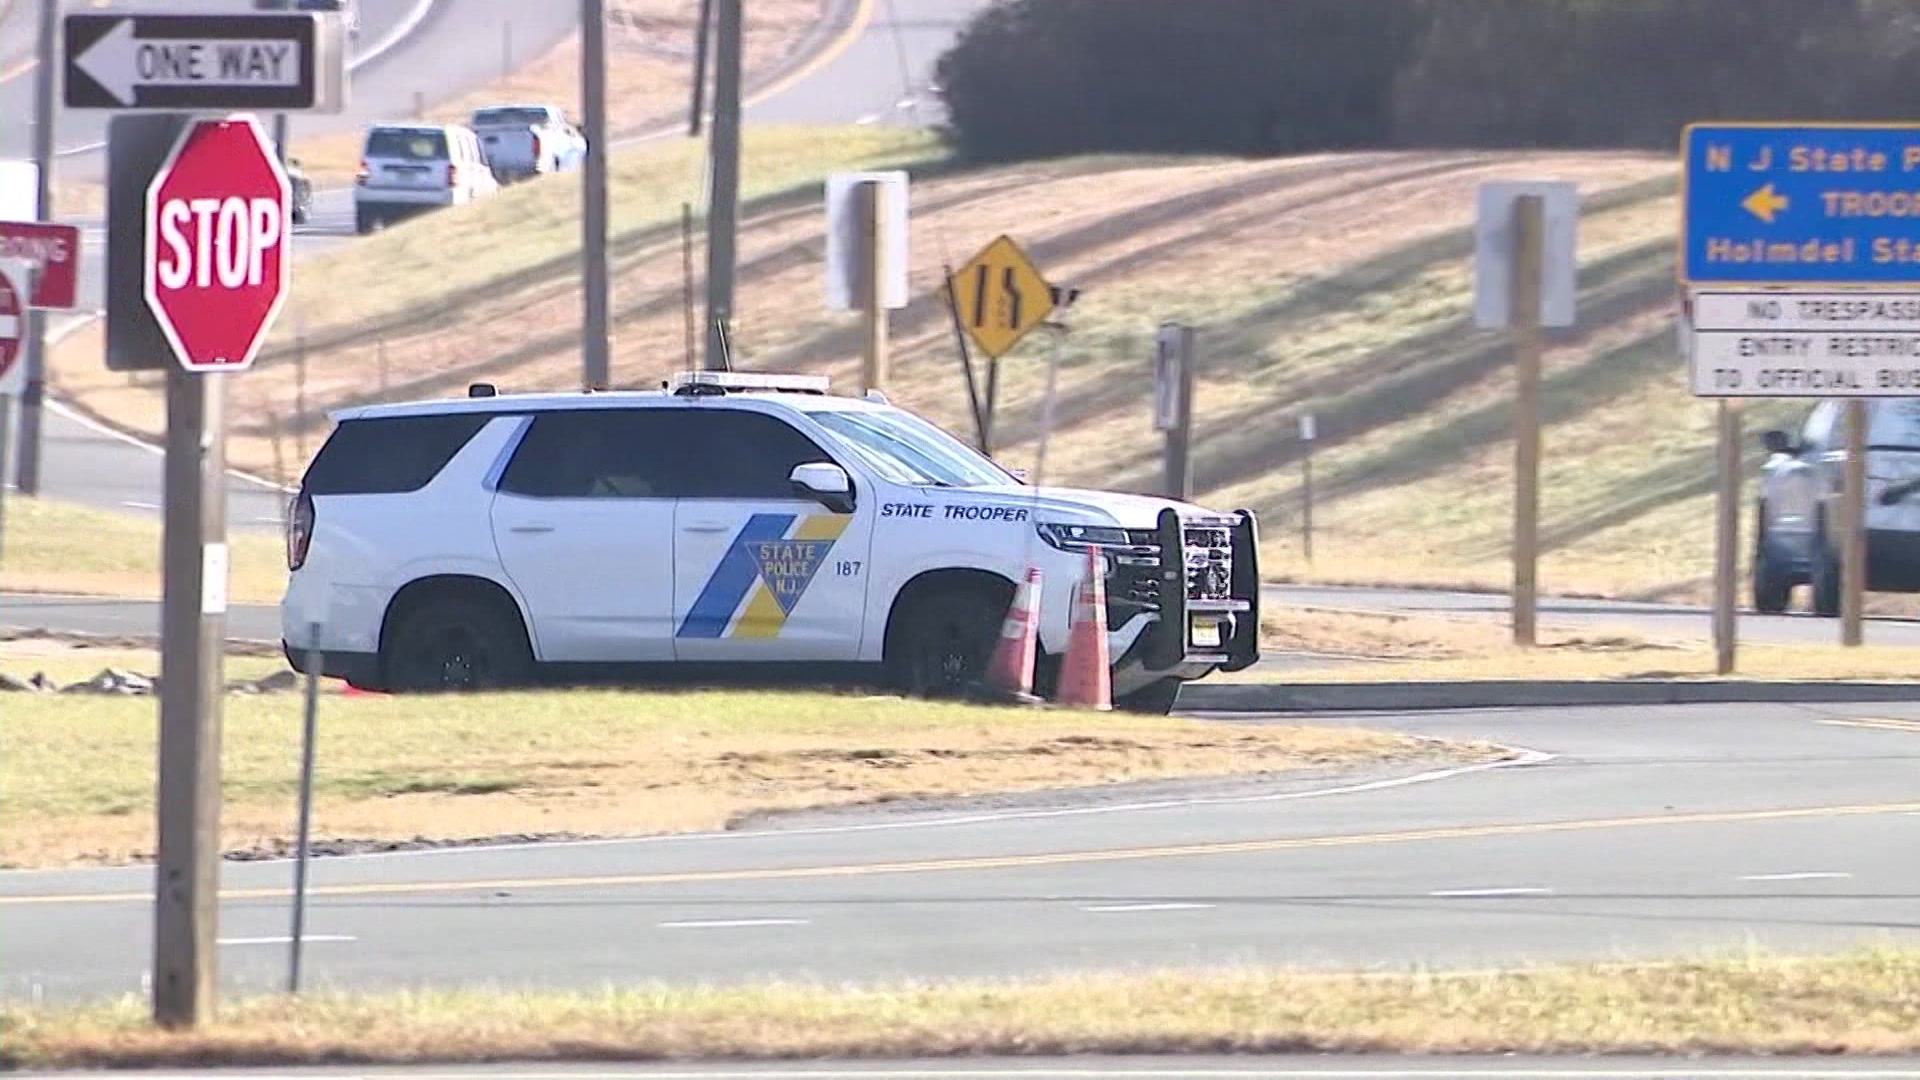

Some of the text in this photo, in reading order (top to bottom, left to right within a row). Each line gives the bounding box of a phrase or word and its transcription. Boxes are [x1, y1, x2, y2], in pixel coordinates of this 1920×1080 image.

[136, 44, 290, 80] ONE WAY
[1705, 146, 1732, 172] N
[1747, 146, 1773, 172] J
[1789, 146, 1887, 172] State
[158, 196, 281, 289] STOP
[1706, 237, 1855, 263] Holmdel
[1747, 301, 1783, 320] NO
[1737, 336, 1812, 357] ENTRY
[1713, 368, 1743, 388] TO
[1757, 368, 1861, 388] OFFICIAL
[881, 503, 1028, 522] STATE TROOPER
[761, 545, 816, 560] STATE
[765, 561, 811, 576] POLICE
[836, 561, 861, 576] 187
